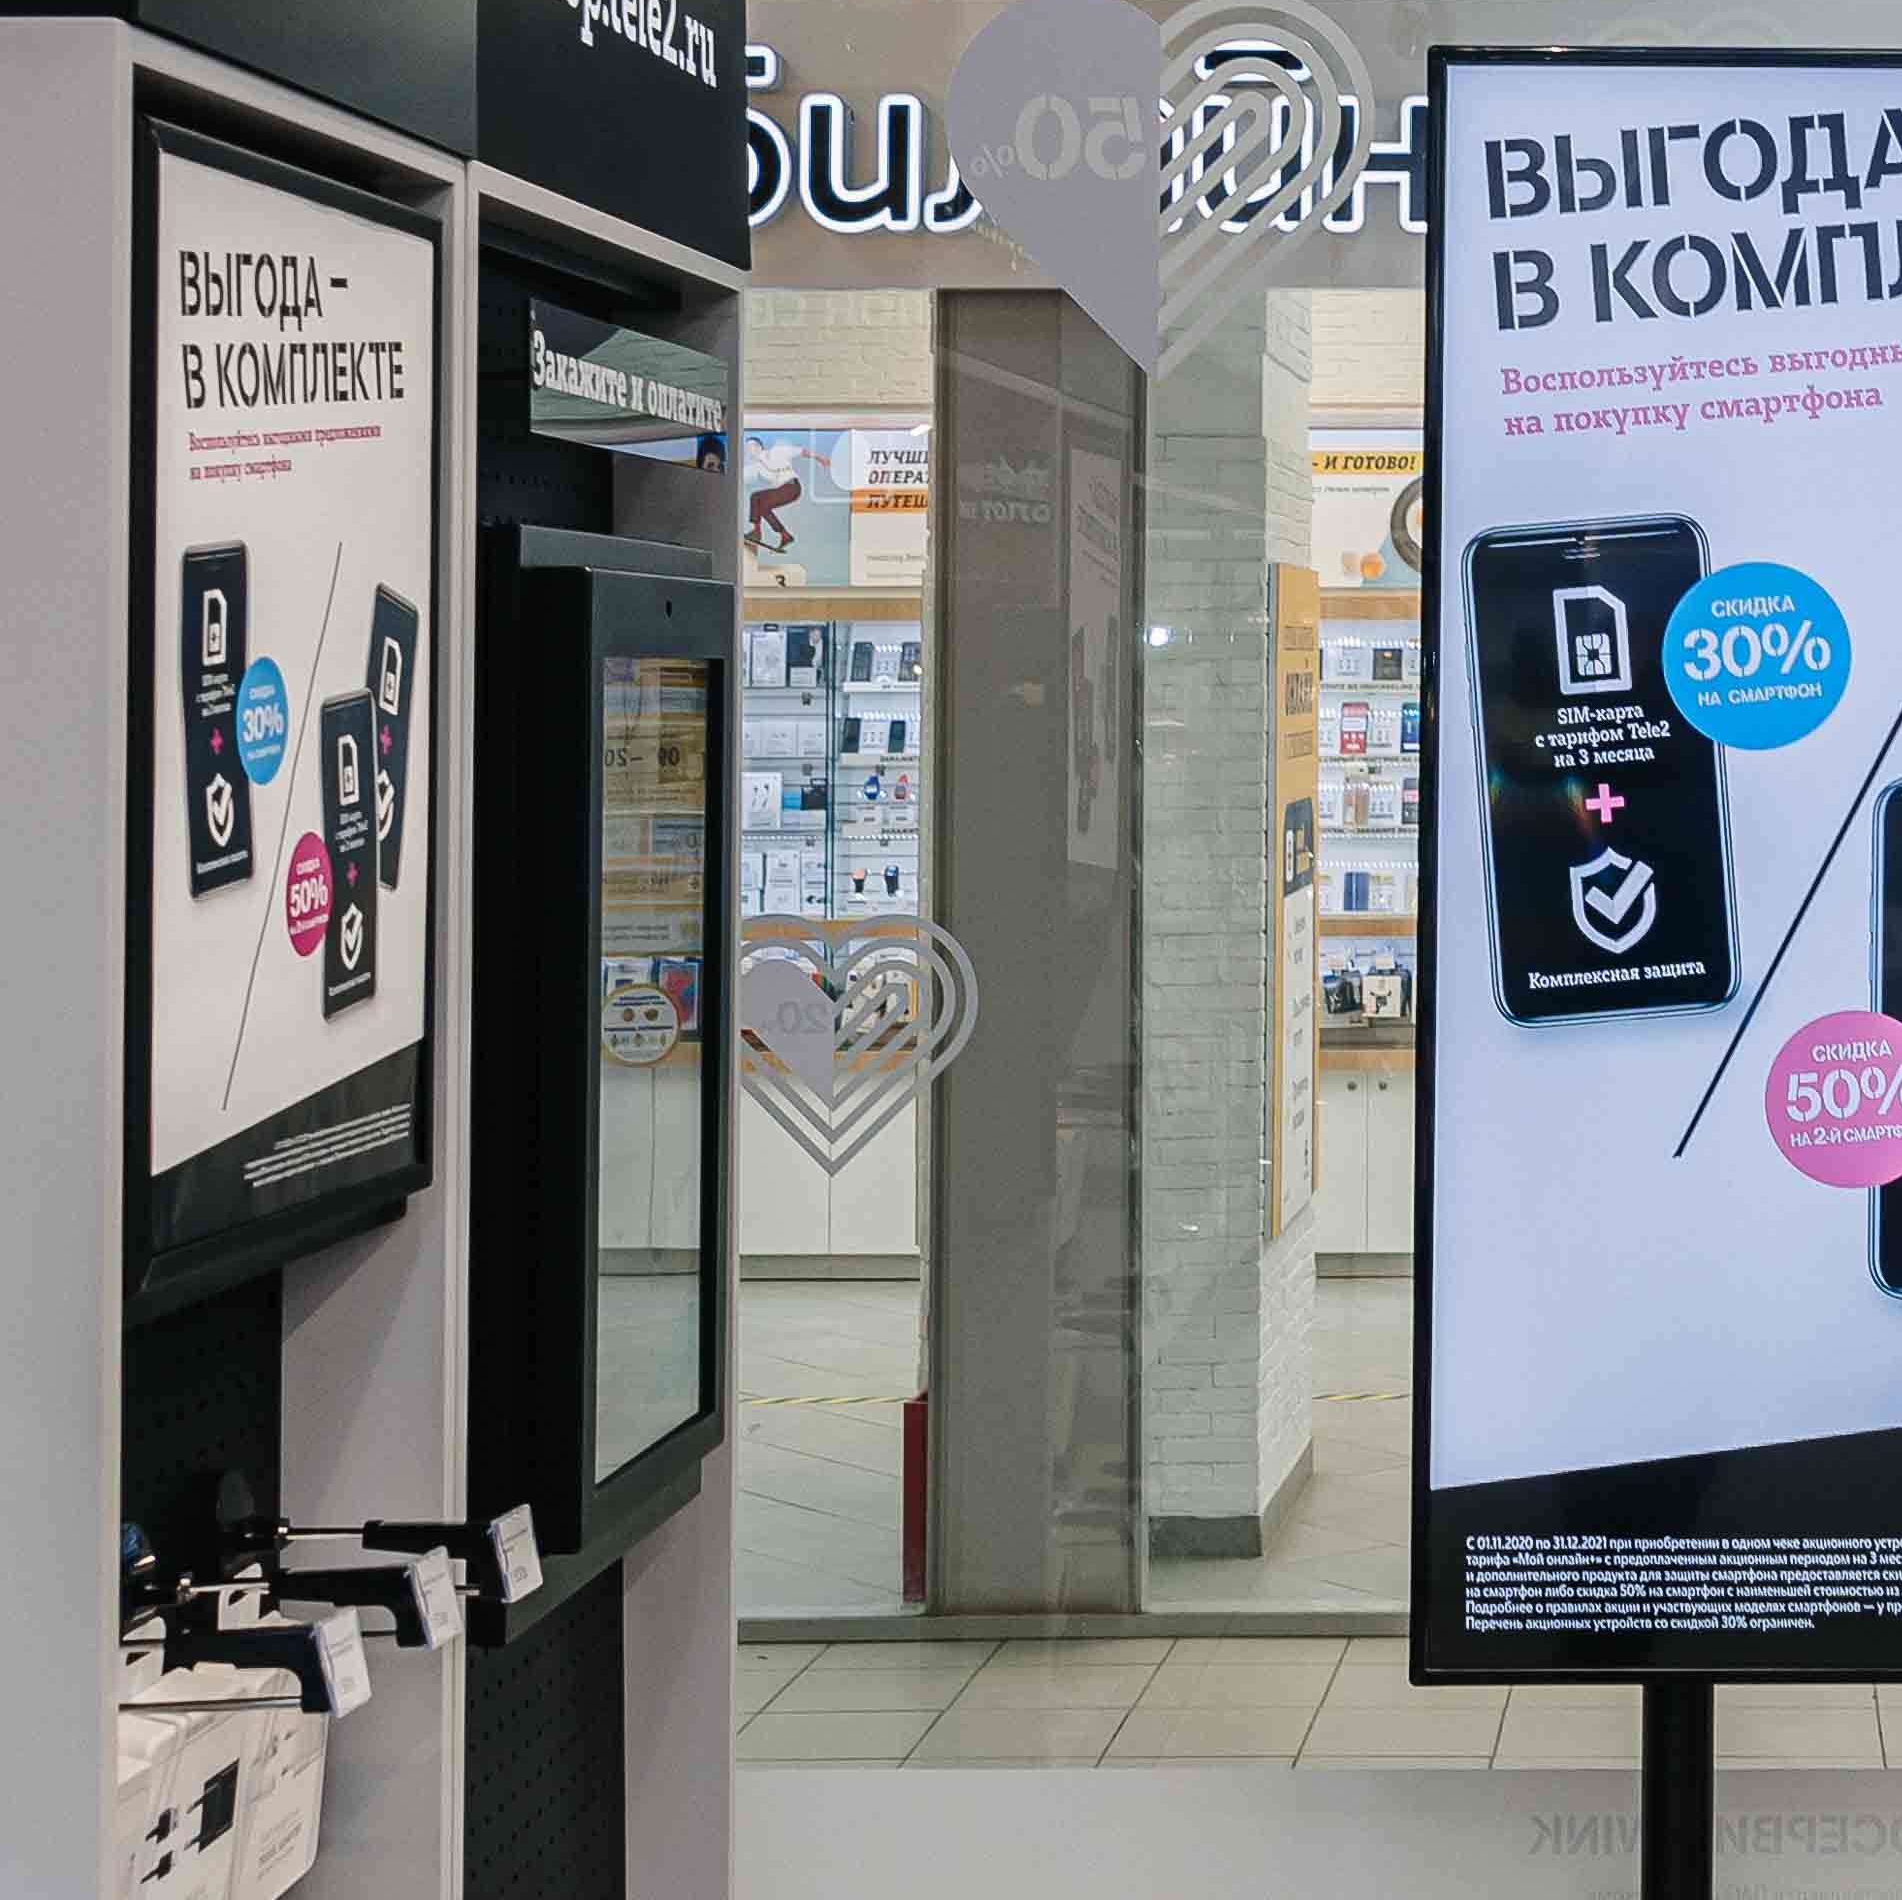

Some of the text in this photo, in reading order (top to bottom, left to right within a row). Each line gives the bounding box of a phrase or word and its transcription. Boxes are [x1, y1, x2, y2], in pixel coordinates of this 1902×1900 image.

[179, 251, 324, 332] ВЫГОДА
[1492, 250, 1560, 331] В
[182, 342, 404, 409] В КОМПЛЕКТЕ
[532, 330, 723, 434] Закажите и оплатите
[1502, 353, 1759, 398] Воспользуйтесь
[1503, 383, 1883, 437] на покупку смартфона
[1324, 455, 1416, 470] И ГОТОВО!
[1711, 595, 1795, 617] СКИДКА
[1683, 621, 1832, 681] 30%
[1697, 683, 1823, 706] НА СМАРТФОН
[242, 700, 285, 744] 30%
[1557, 704, 1644, 726] SIM-карта
[1535, 721, 1672, 748] с тарифом Tele2
[1554, 745, 1655, 768] на 3 месяца
[289, 874, 329, 919] 50%
[1528, 960, 1706, 990] Комплексная защита
[1811, 1039, 1892, 1062] СКИДКА
[1790, 1133, 1812, 1148] НА
[1813, 1126, 1841, 1145] 2-Й
[1477, 1536, 1534, 1549] 01.11.2020
[1536, 1539, 1550, 1549] по
[1553, 1536, 1607, 1549] 31.12.2021
[1610, 1539, 1632, 1552] при
[1634, 1536, 1720, 1552] приобретении
[1732, 1538, 1770, 1551] одном
[1772, 1538, 1800, 1549] чеке
[1802, 1538, 1872, 1551] акционного
[1466, 1554, 1510, 1569] тарифа
[1613, 1555, 1717, 1568] предоплаченным
[1720, 1554, 1788, 1567] акционным
[1790, 1555, 1850, 1568] периодом
[1852, 1554, 1868, 1565] на
[1477, 1570, 1579, 1584] дополнительного
[1582, 1571, 1638, 1585] продукта
[1639, 1571, 1662, 1582] для
[1663, 1570, 1710, 1582] защиты
[1712, 1568, 1778, 1583] смартфона
[1780, 1569, 1880, 1583] предоставляется
[1466, 1588, 1481, 1597] на
[1483, 1585, 1543, 1600] смартфон
[1545, 1585, 1574, 1597] либо
[1576, 1587, 1618, 1599] скидка
[1620, 1584, 1647, 1597] 50%
[1649, 1587, 1663, 1597] на
[1665, 1584, 1725, 1601] смартфон
[1736, 1584, 1811, 1597] наименьшей
[1813, 1586, 1884, 1597] стоимостью
[1886, 1587, 1900, 1597] из
[1466, 1601, 1533, 1615] Подробнее
[1547, 1602, 1602, 1615] правилах
[1605, 1603, 1640, 1615] акции
[1652, 1601, 1732, 1616] участвующих
[1734, 1601, 1786, 1614] моделях
[1788, 1600, 1861, 1616] смартфонов
[1466, 1617, 1523, 1632] Перечень
[1525, 1620, 1591, 1631] акционных
[1593, 1617, 1652, 1632] устройств
[1654, 1620, 1668, 1629] со
[1670, 1616, 1719, 1631] скидкой
[1721, 1615, 1747, 1629] 30%
